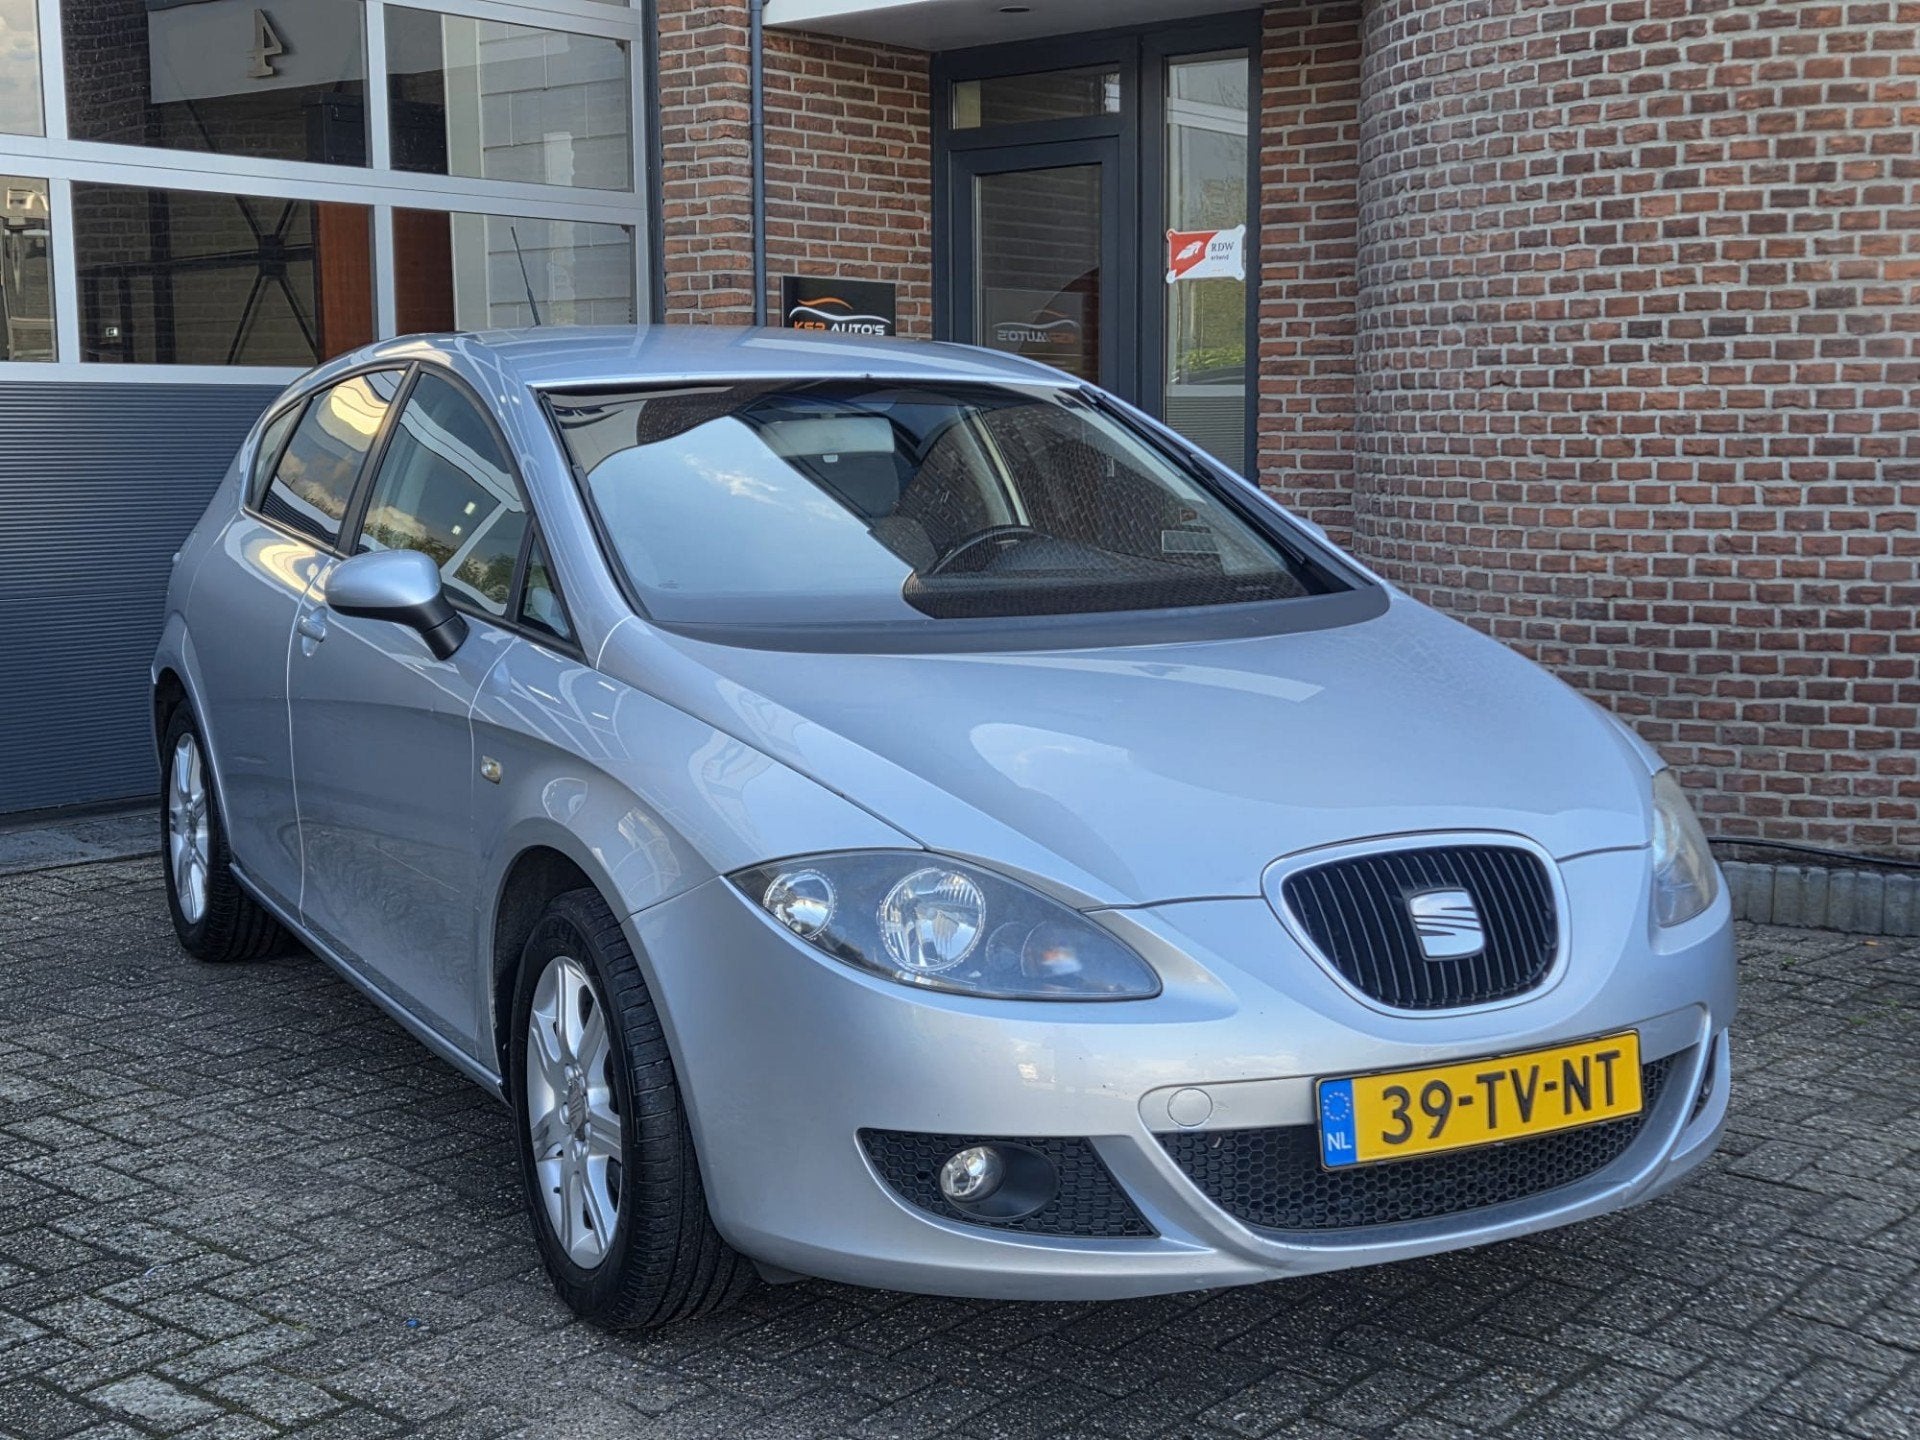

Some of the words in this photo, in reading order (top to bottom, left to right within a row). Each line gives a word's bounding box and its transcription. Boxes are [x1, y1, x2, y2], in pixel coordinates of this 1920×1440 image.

[1211, 241, 1235, 252] RDW
[1381, 1049, 1621, 1145] 39-TV-NT
[1327, 1131, 1352, 1152] NL
